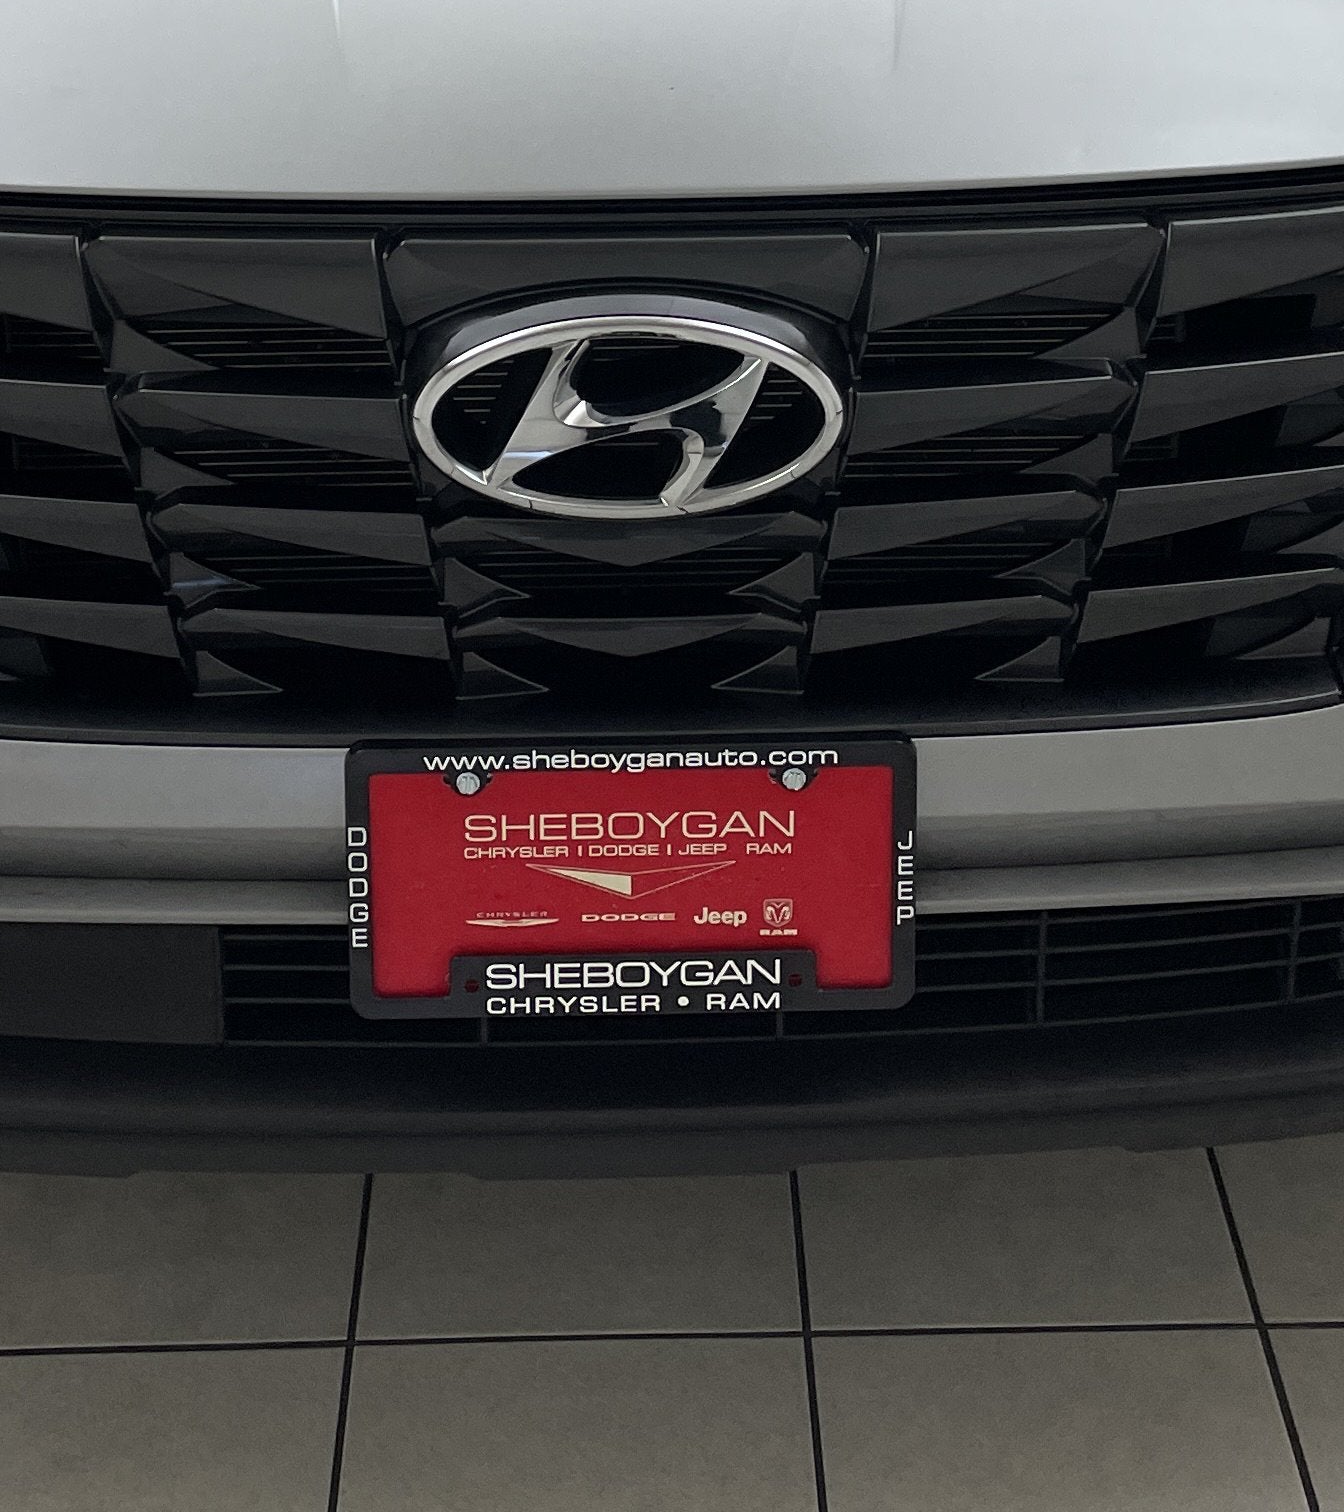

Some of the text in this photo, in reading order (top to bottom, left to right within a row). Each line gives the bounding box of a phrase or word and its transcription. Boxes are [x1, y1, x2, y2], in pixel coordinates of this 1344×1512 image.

[423, 748, 838, 773] www.sheboyganauto.com
[463, 809, 795, 843] SHEBOYGAN
[463, 842, 792, 860] CHRYSLER DODGE JEEP RAM
[347, 826, 368, 948] DODGE
[896, 830, 914, 926] JEEP
[476, 911, 549, 919] CHRYSLER
[581, 912, 676, 922] DODGE
[693, 906, 747, 927] Jeep
[759, 928, 798, 936] RAM
[484, 959, 782, 991] SHEBOYGAN
[486, 991, 782, 1015] CHRYSLER RAM
